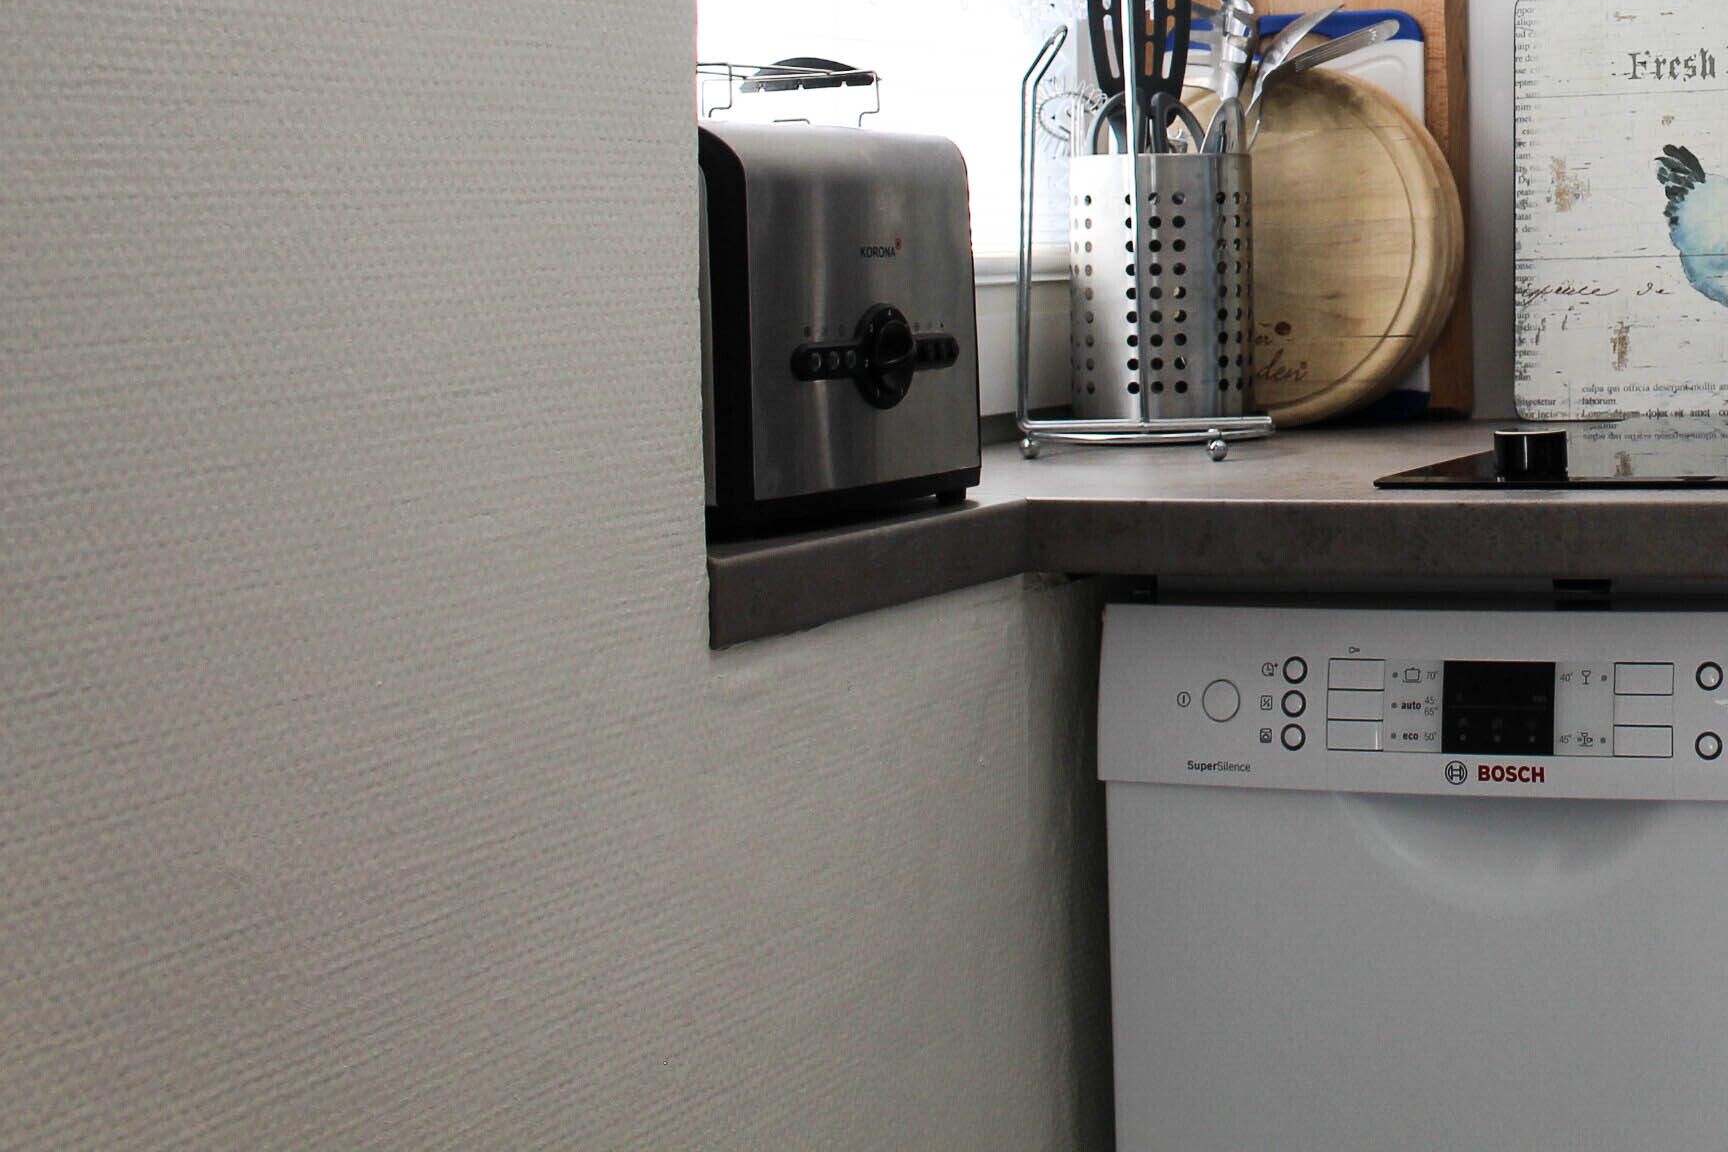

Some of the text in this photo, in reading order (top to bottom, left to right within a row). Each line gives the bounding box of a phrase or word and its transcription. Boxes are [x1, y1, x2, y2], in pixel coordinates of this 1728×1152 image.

[1626, 47, 1716, 82] Fresh
[860, 246, 896, 258] KORONA
[1582, 384, 1604, 394] culpa
[1623, 383, 1650, 393] officia
[1401, 701, 1422, 710] auto
[1402, 732, 1419, 741] eco
[1187, 760, 1251, 772] SuperSilence
[1477, 765, 1545, 783] BOSCH
